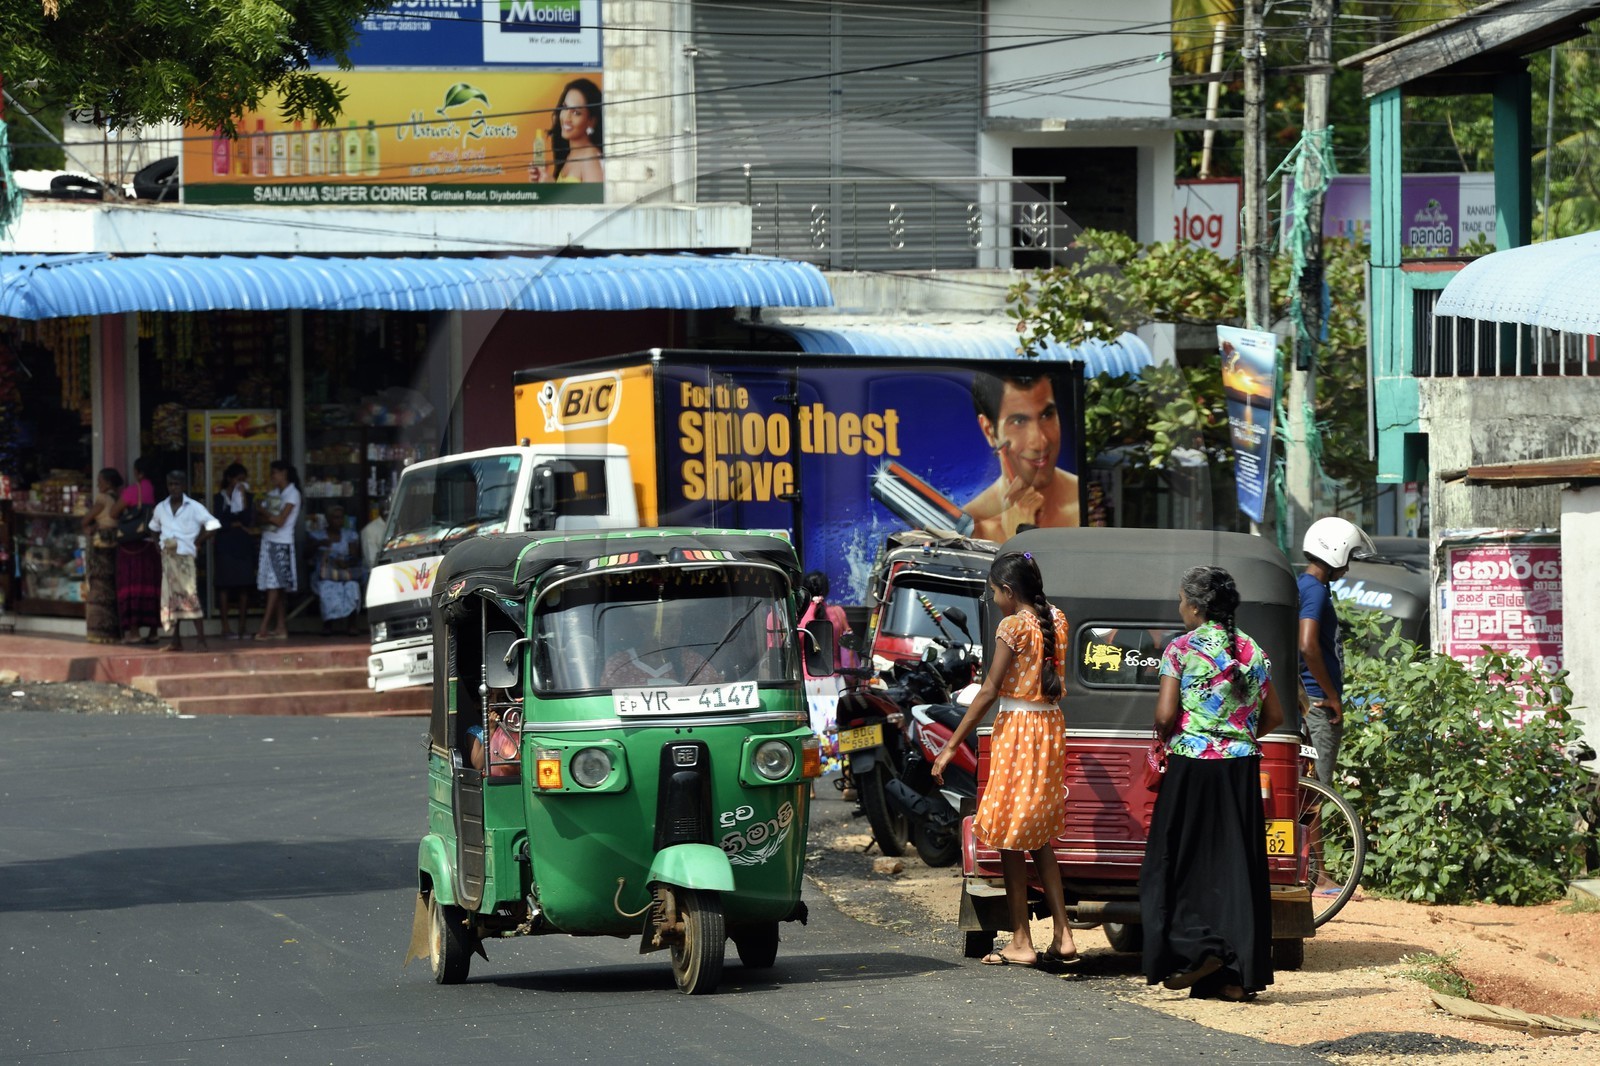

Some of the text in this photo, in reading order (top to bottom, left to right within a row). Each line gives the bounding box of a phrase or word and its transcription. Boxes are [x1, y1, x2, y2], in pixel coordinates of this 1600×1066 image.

[506, 0, 575, 23] Mobitel
[253, 186, 319, 201] SANJANA
[321, 186, 367, 201] SUPER
[370, 186, 428, 201] CORNER
[465, 190, 488, 202] Road,
[1410, 224, 1453, 247] panda
[680, 382, 711, 409] For
[681, 458, 795, 502] shave
[640, 691, 671, 711] YR
[698, 684, 755, 707] 4147
[677, 752, 694, 762] RE
[1269, 839, 1286, 853] 82
